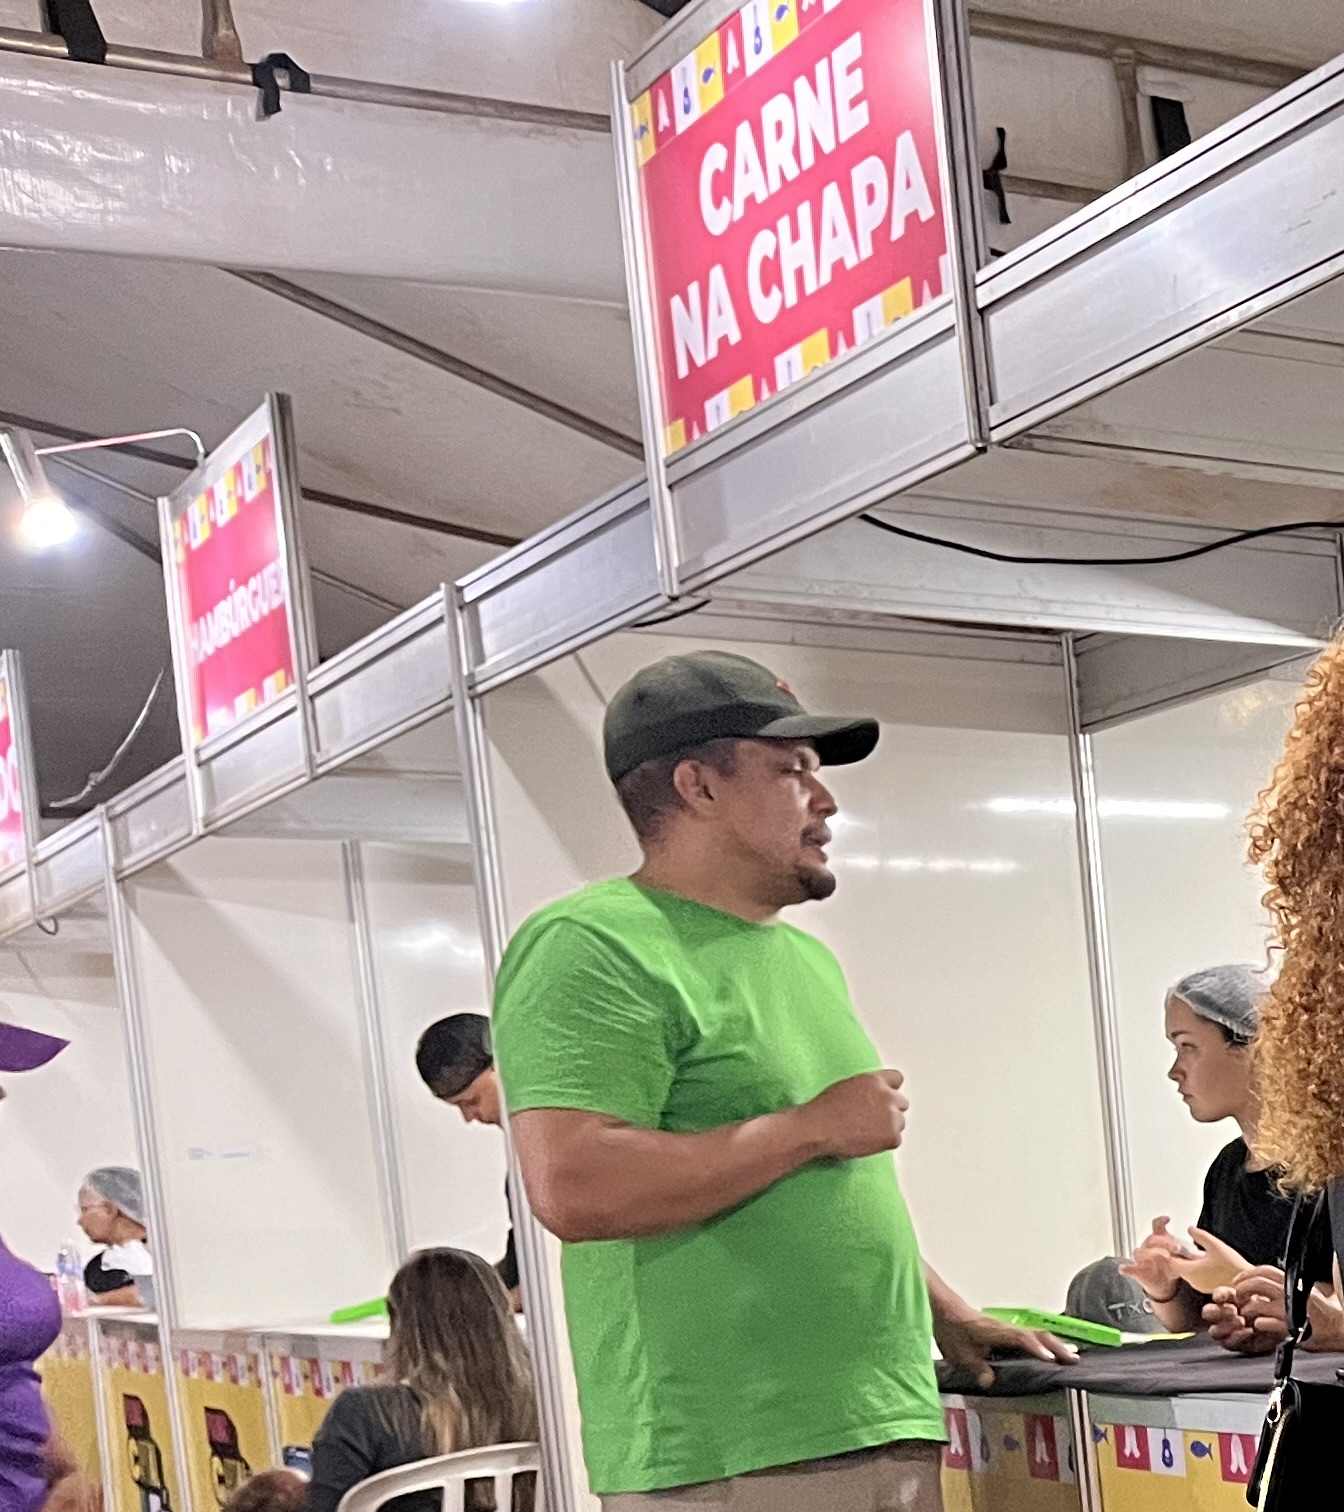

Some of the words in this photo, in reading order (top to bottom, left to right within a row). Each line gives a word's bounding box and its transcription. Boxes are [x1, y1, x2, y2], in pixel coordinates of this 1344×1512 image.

[699, 32, 870, 236] CARNE
[670, 264, 742, 379] NA
[747, 130, 936, 324] CHAPA
